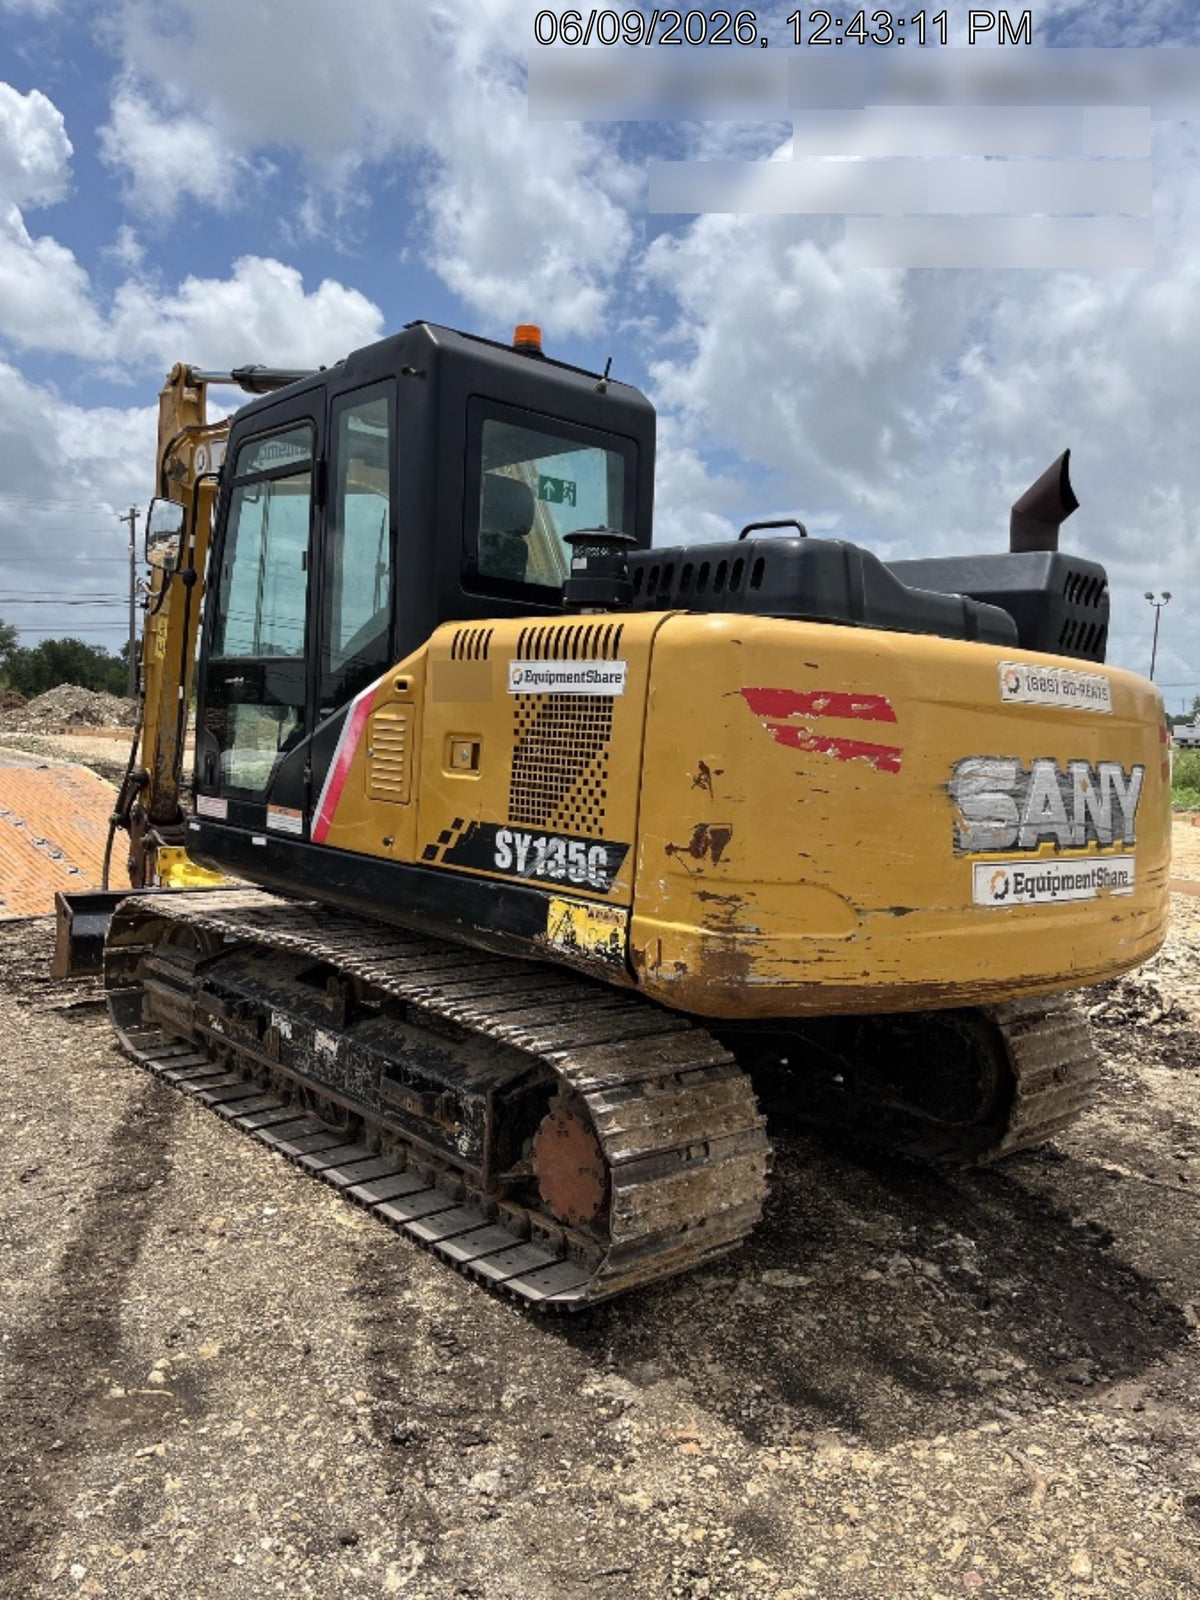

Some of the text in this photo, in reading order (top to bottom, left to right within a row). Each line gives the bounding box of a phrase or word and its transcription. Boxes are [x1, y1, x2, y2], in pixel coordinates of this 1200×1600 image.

[524, 669, 622, 686] EquipmentShare
[946, 755, 1145, 854] SANY
[494, 829, 609, 887] SY135C
[1012, 867, 1128, 898] EquipmentShare
